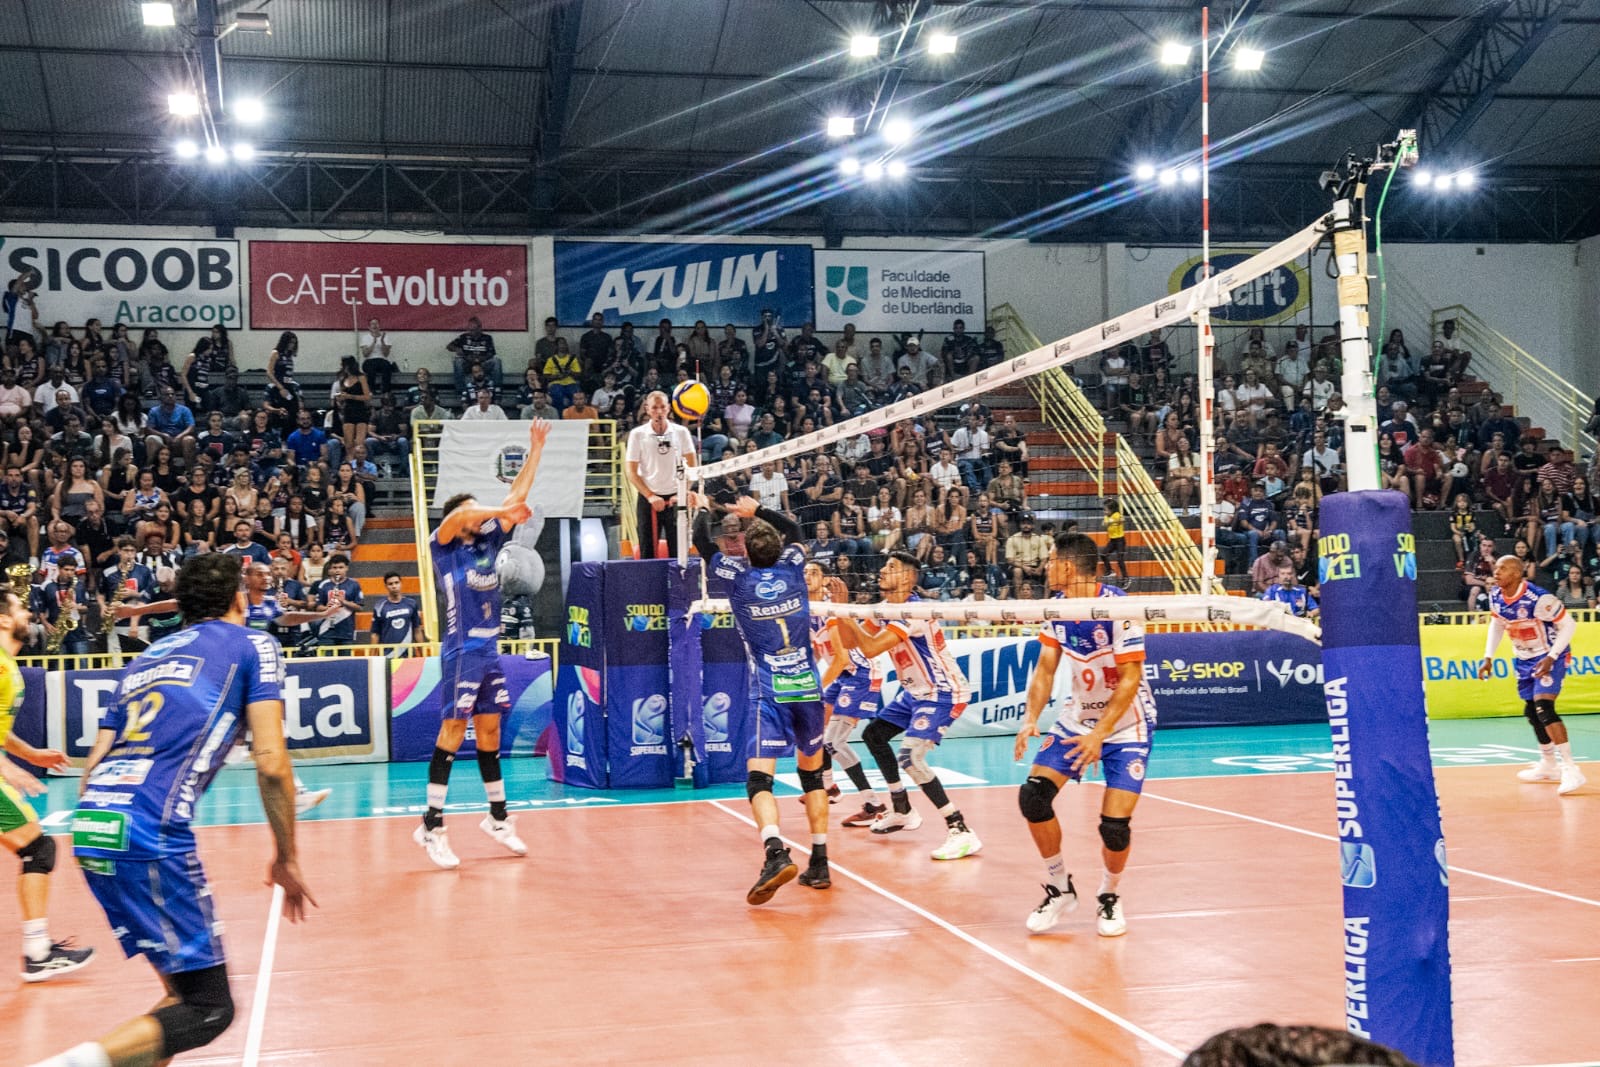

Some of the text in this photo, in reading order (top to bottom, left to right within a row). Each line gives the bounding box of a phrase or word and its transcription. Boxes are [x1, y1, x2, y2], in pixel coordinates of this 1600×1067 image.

[8, 247, 233, 292] SICOOB
[881, 269, 951, 283] Faculdade
[266, 266, 509, 306] CAFÉ Evolutto
[586, 250, 779, 321] AZULIM
[882, 286, 961, 299] de Medicina
[114, 300, 236, 324] Aracoop
[882, 301, 974, 315] de Uberlândia
[750, 598, 801, 617] Renata
[1082, 668, 1096, 692] 9
[1192, 661, 1246, 679] SHOP
[1426, 656, 1509, 681] BANO
[1081, 701, 1109, 710] SICO
[630, 745, 667, 756] SUPERLIGA
[1323, 676, 1363, 838] SUPERLIGA
[1345, 916, 1371, 1041] PERLIGA
